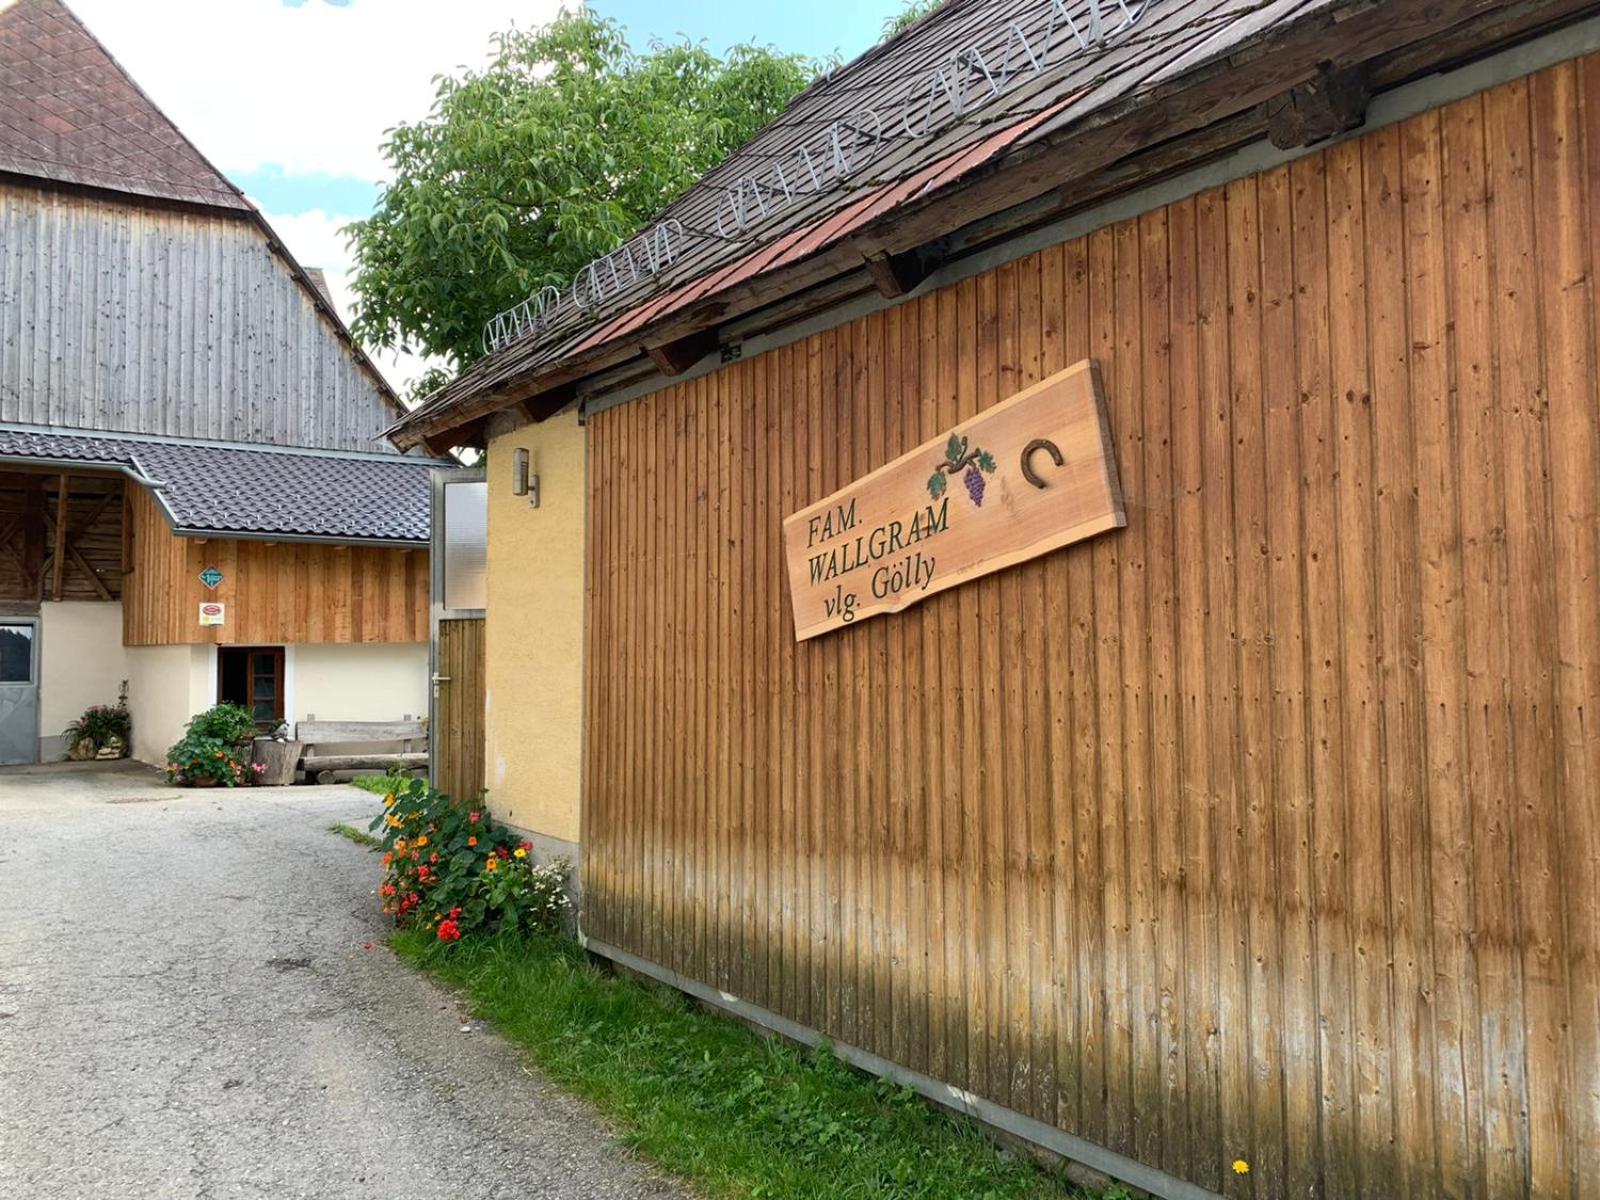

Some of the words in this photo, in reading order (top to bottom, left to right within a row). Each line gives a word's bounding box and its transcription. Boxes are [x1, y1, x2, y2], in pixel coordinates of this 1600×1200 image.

[807, 498, 862, 548] FAM.
[808, 497, 949, 586] WALLGRAM
[824, 585, 861, 622] vlg.
[872, 552, 935, 599] Gölly
